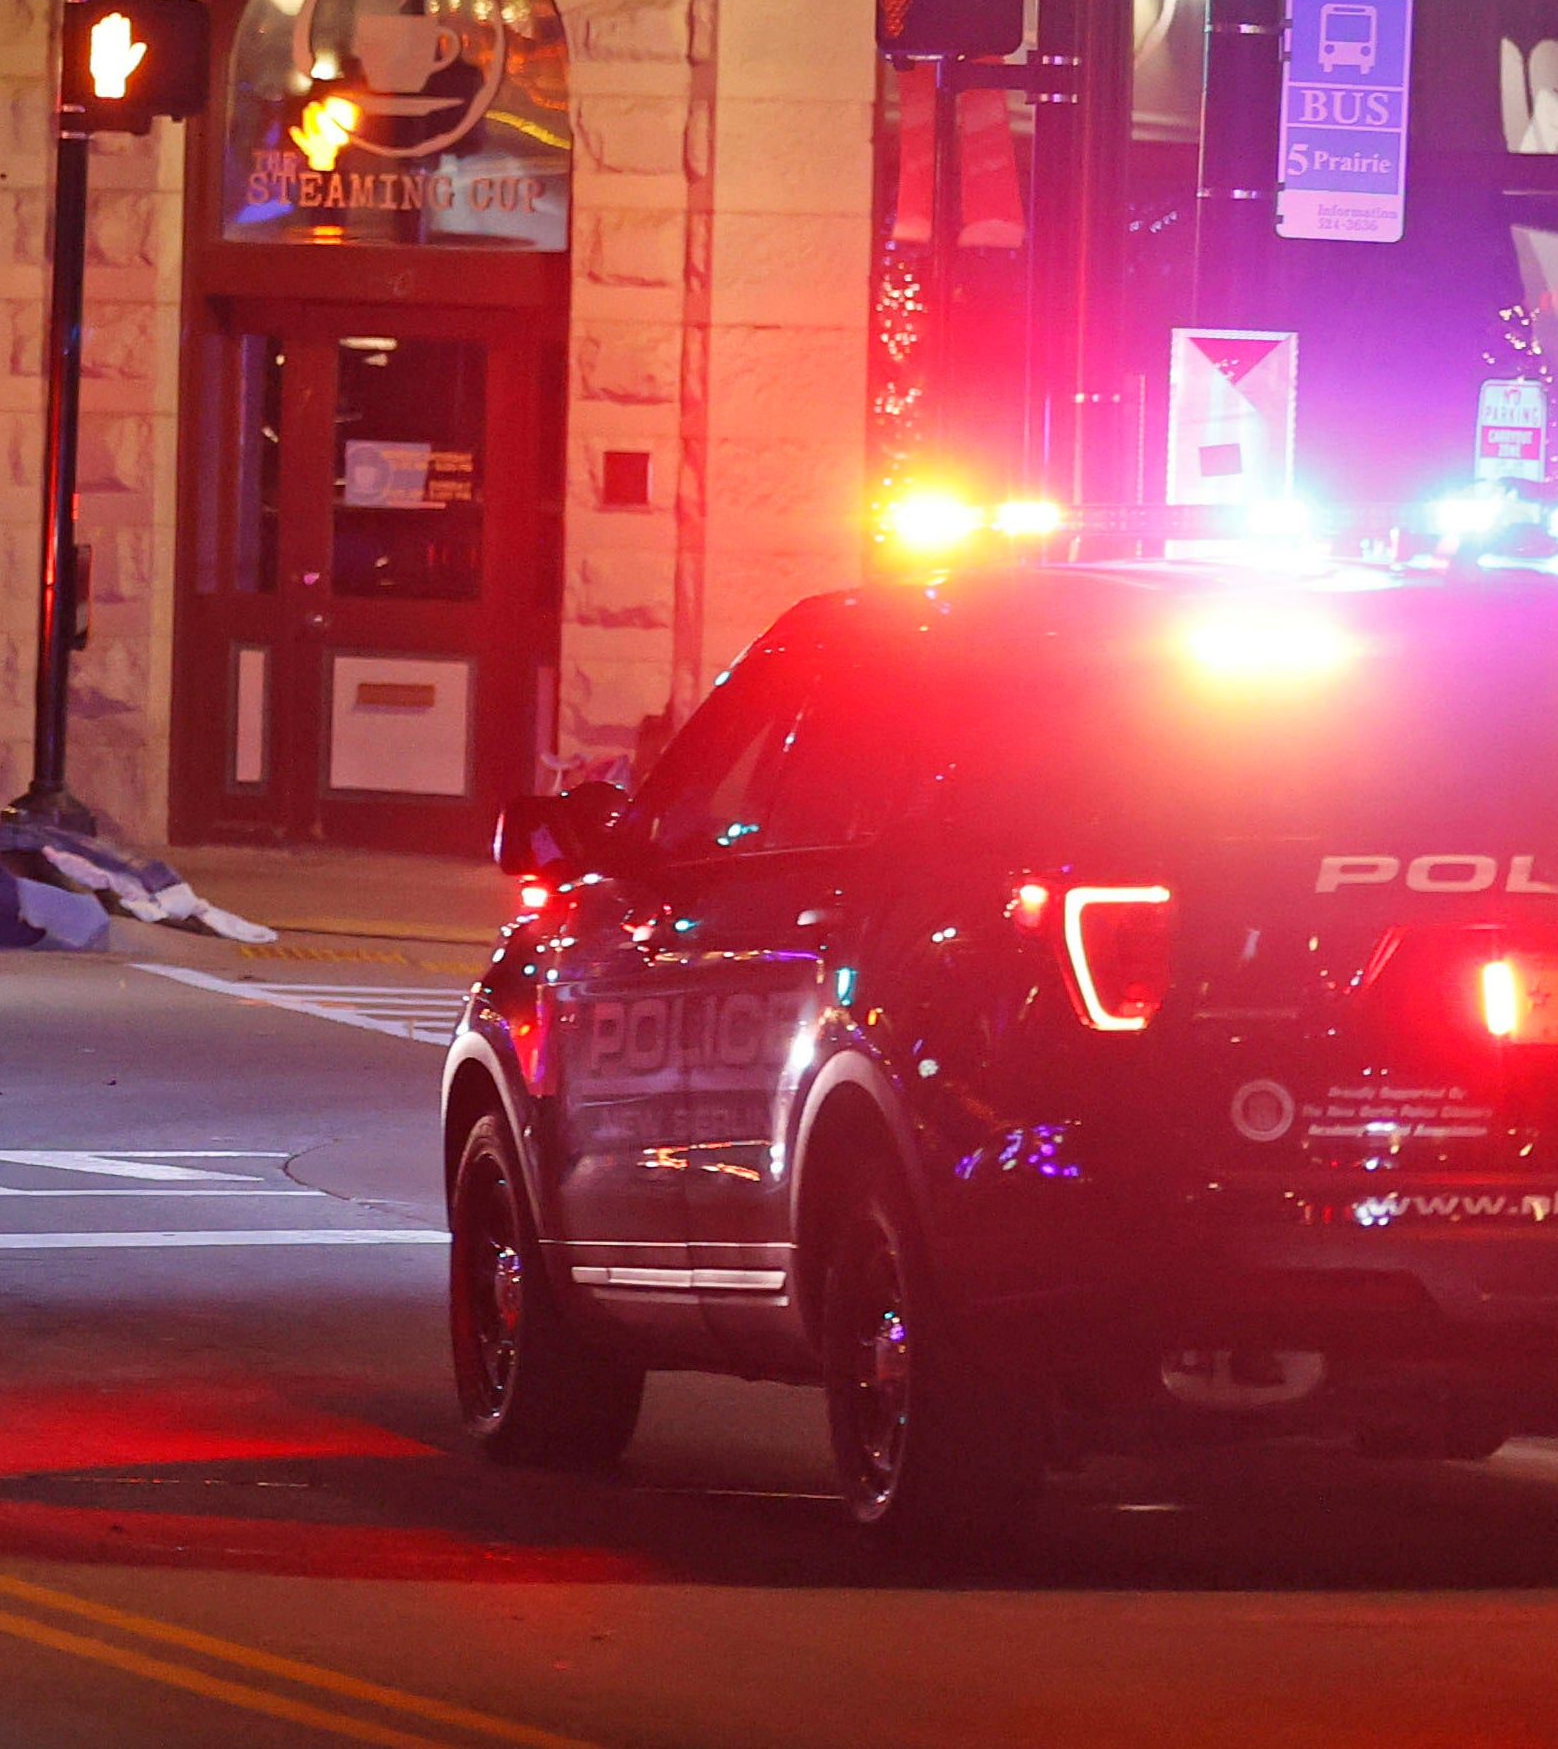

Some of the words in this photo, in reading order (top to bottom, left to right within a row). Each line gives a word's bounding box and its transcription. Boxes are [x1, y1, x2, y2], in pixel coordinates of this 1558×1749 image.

[1299, 89, 1390, 126] BUS
[1287, 143, 1310, 176] 5
[1313, 150, 1392, 174] Prairie
[246, 172, 455, 211] STEAMING
[467, 177, 547, 213] CUP
